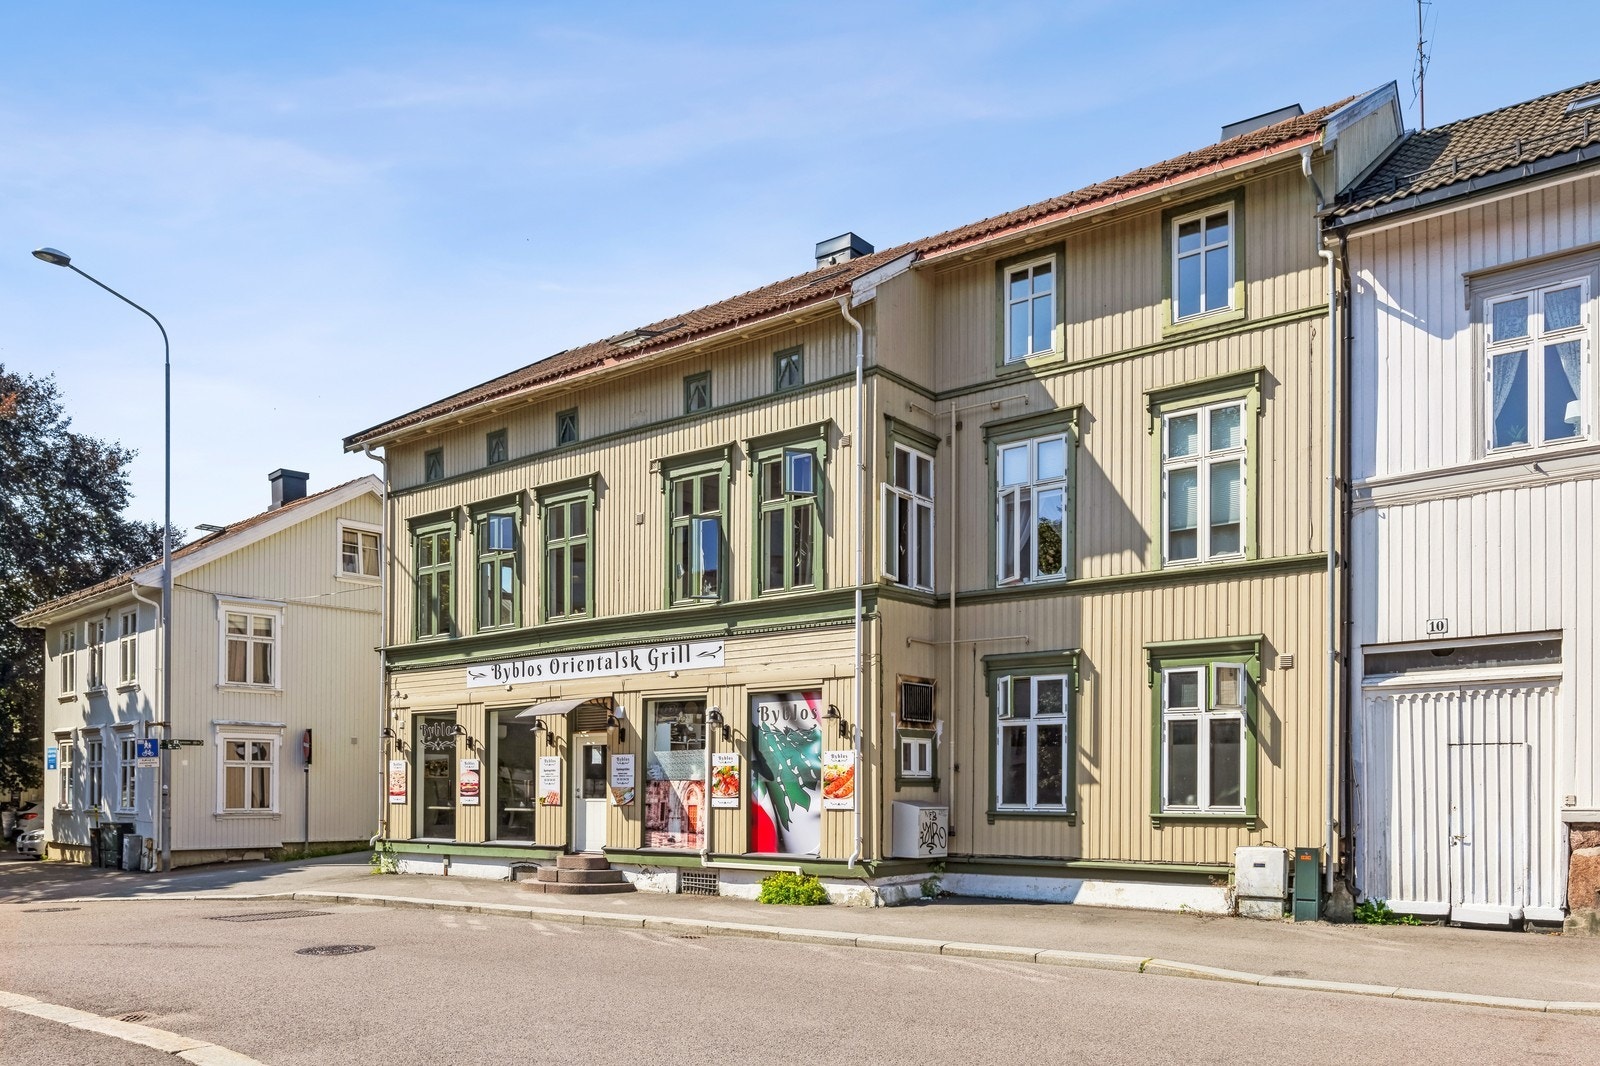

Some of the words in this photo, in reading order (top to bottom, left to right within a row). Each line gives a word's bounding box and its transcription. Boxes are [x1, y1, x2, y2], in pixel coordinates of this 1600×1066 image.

[1429, 620, 1445, 632] 10
[491, 660, 543, 684] Byblos
[549, 649, 643, 675] Orientalsk
[647, 643, 691, 672] Grill
[757, 703, 818, 726] Byblos
